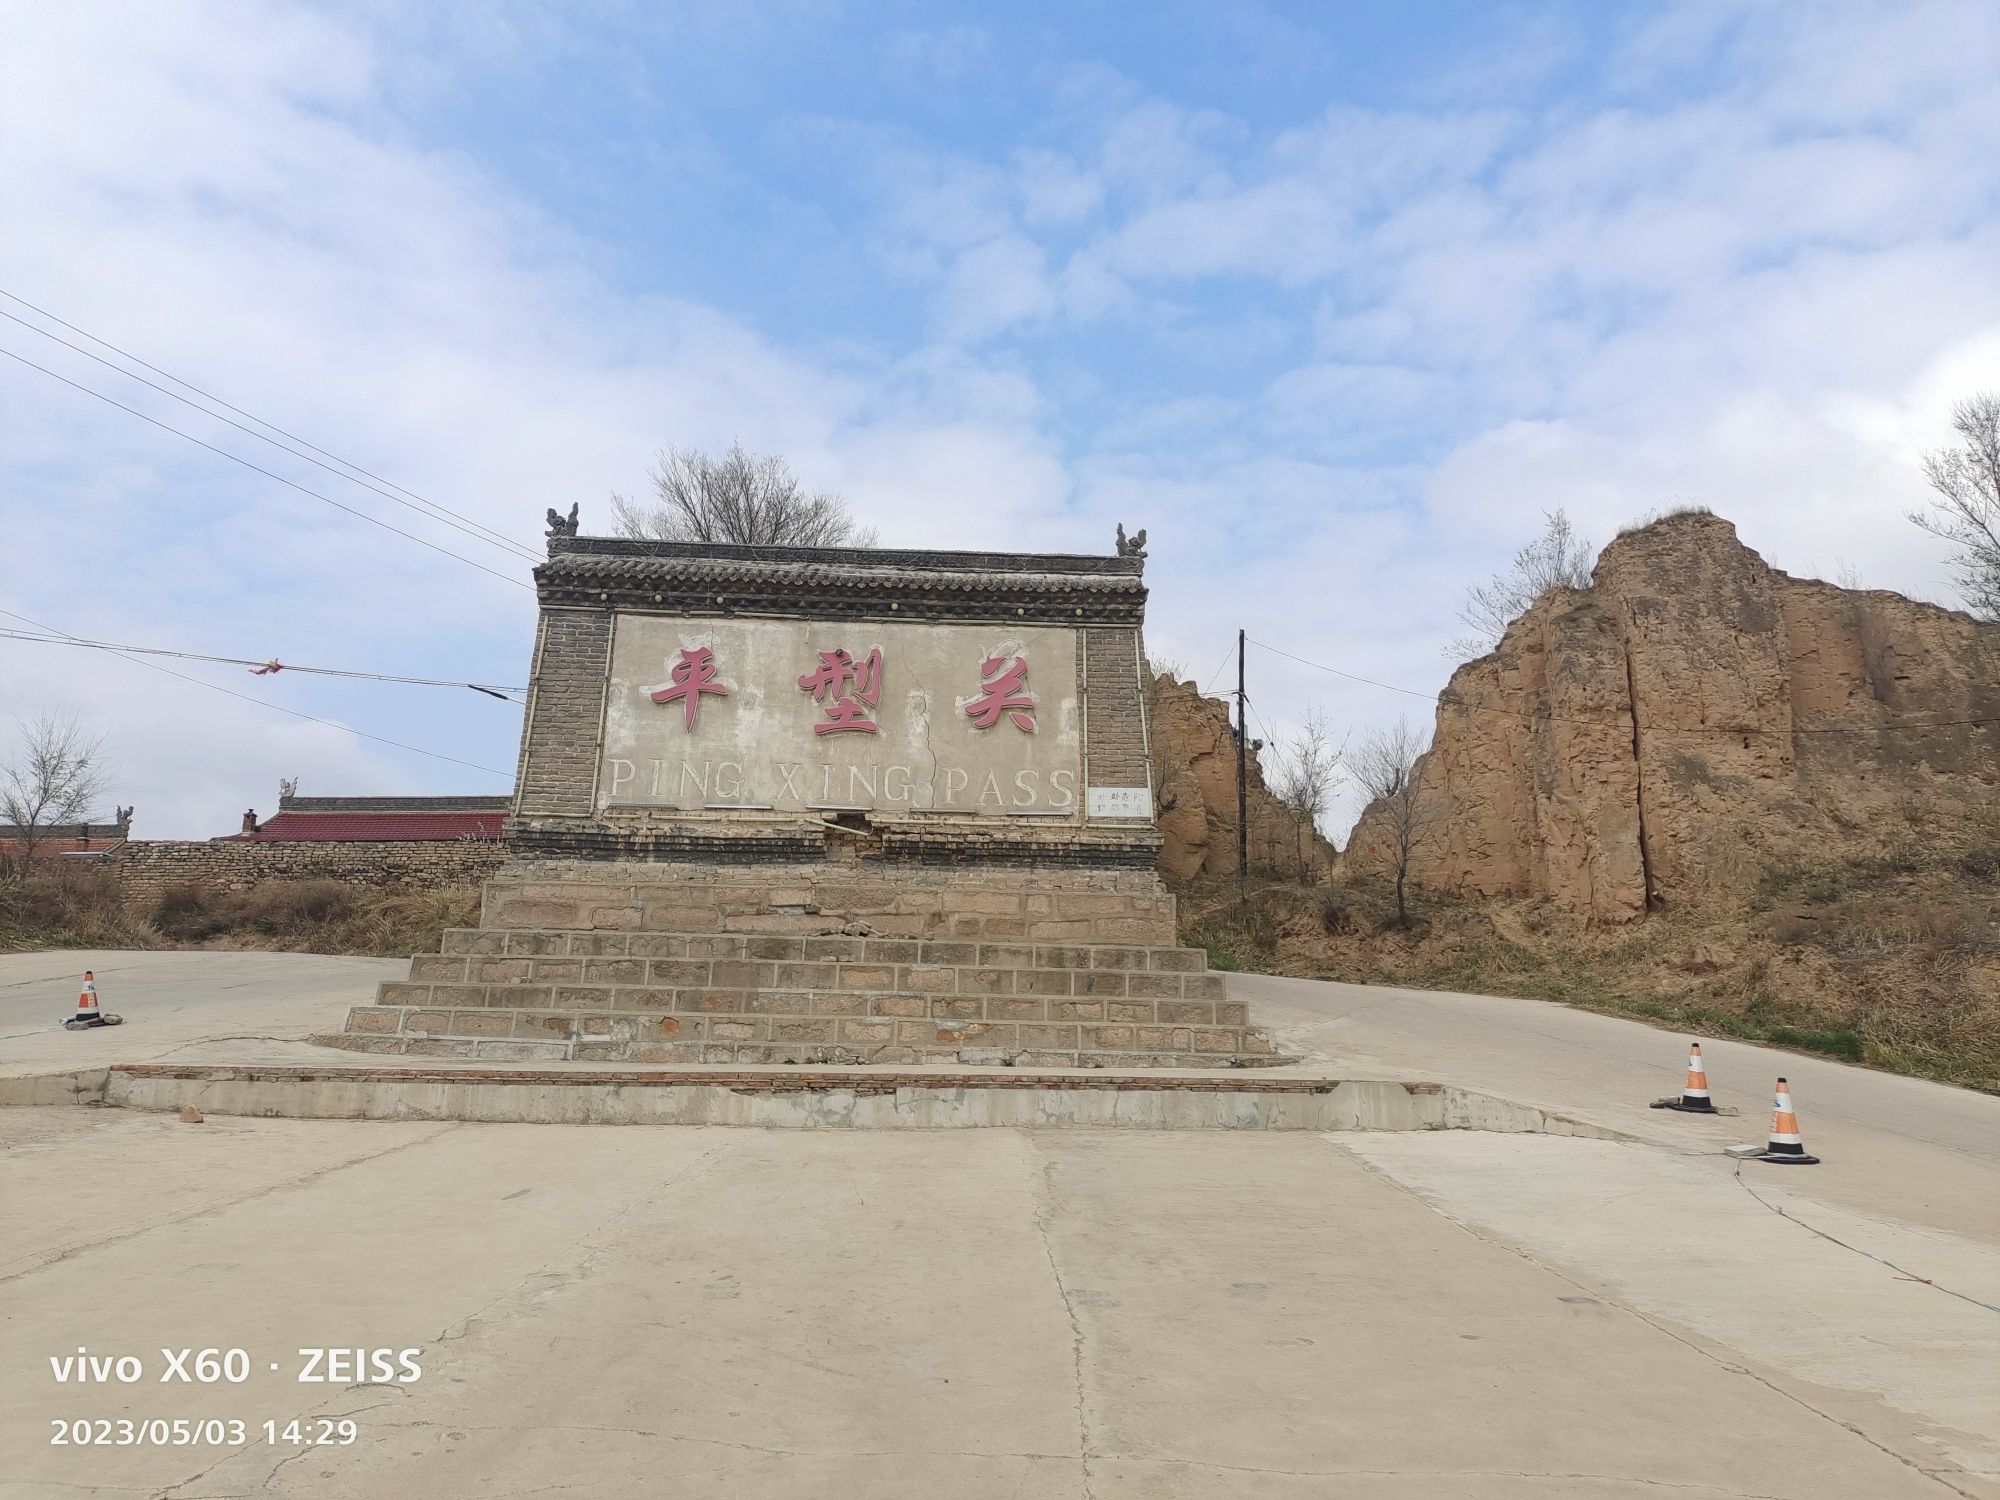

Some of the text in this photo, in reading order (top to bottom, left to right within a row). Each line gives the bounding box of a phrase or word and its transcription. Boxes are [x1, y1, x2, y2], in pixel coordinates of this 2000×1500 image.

[651, 646, 1035, 734] 平型关
[608, 758, 1075, 808] PING XING PASS
